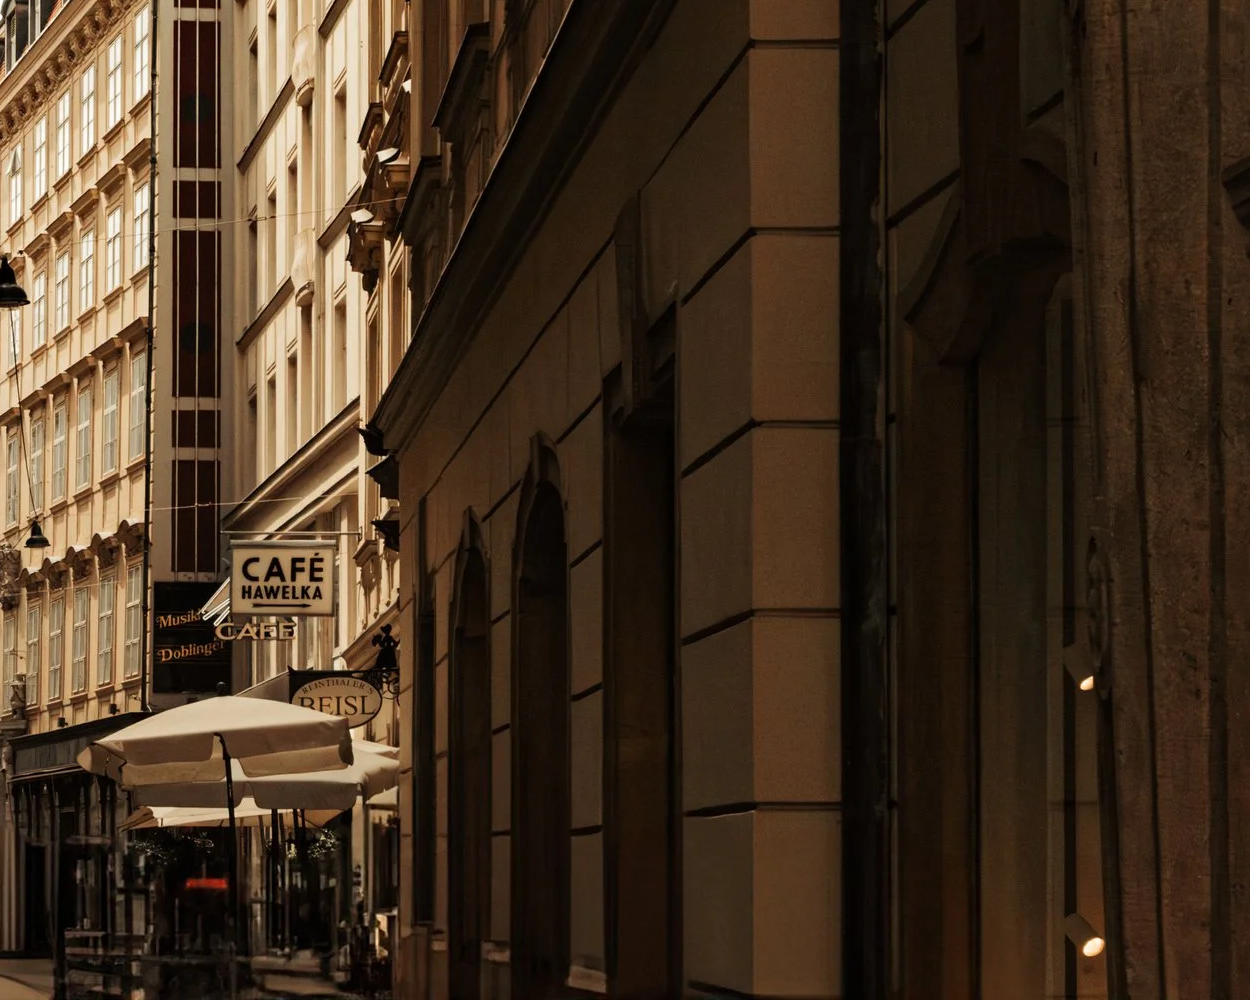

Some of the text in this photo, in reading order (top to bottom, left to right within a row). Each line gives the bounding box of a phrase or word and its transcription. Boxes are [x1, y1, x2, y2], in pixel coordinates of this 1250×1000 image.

[241, 552, 325, 583] CAFÉ
[241, 584, 323, 600] HAWELKA
[157, 640, 225, 664] Doblinger
